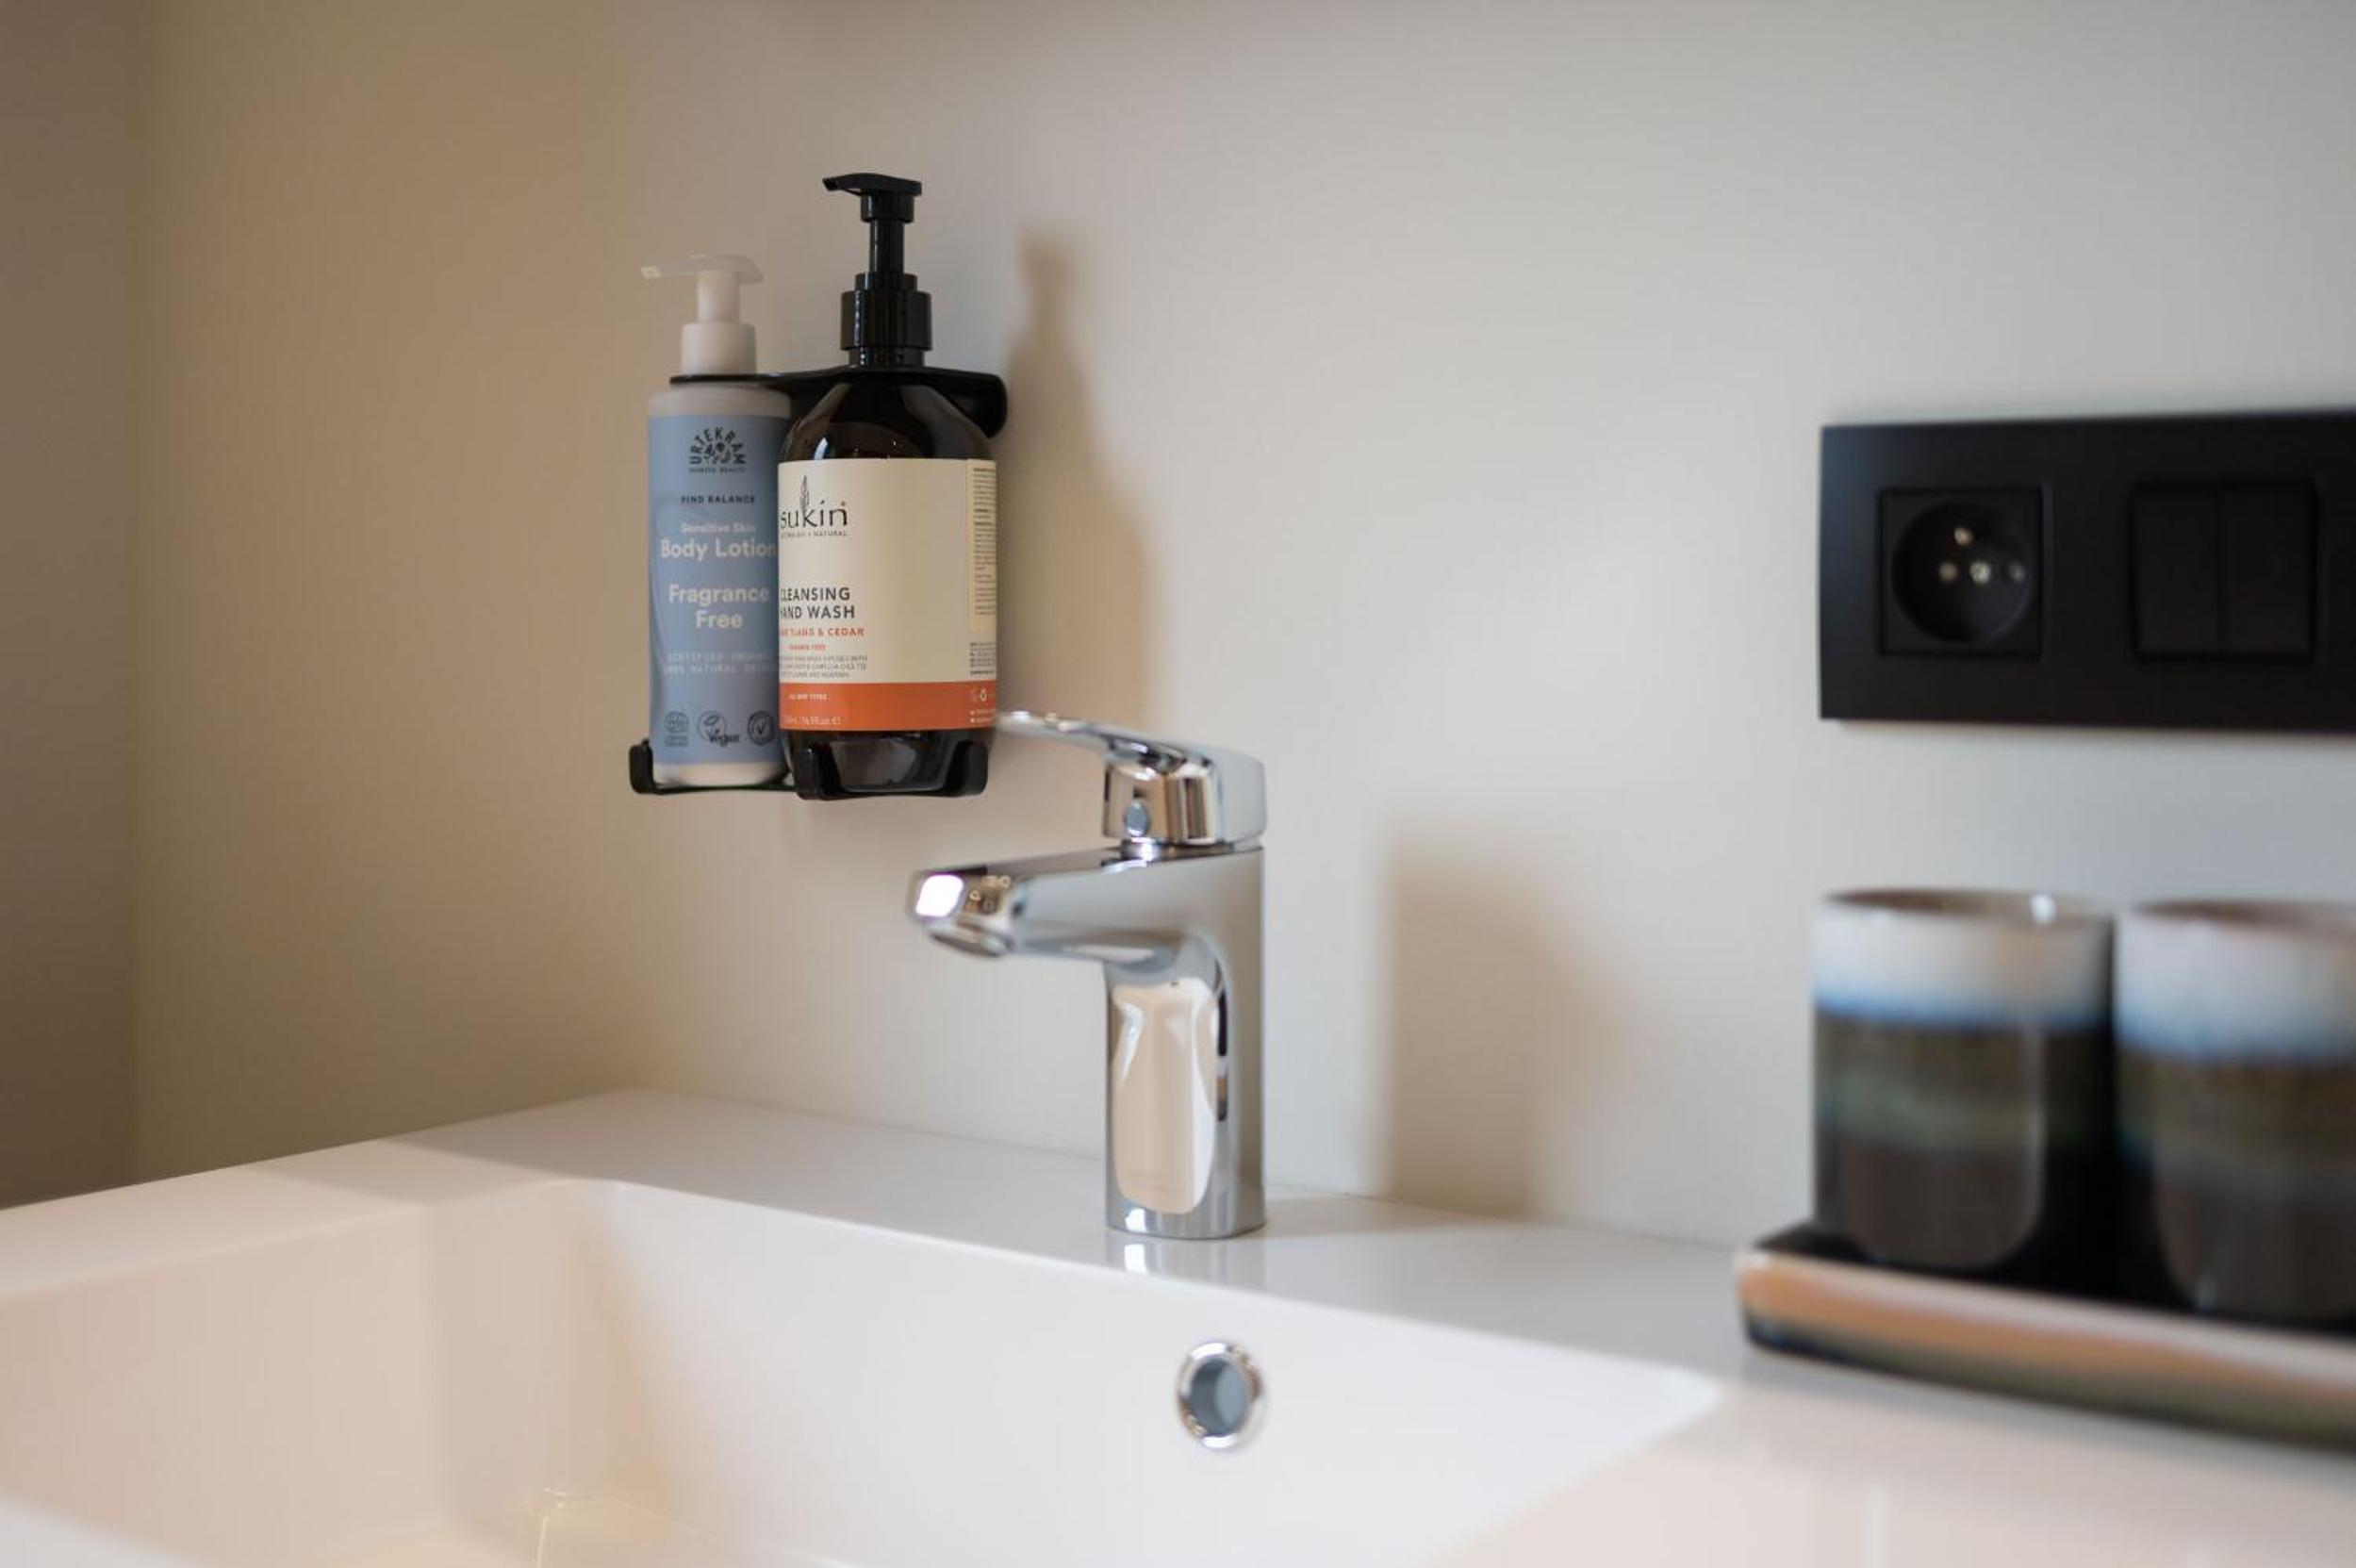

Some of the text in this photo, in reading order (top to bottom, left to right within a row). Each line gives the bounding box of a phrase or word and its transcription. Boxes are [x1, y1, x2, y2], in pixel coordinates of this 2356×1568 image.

[689, 427, 747, 465] URTEKRAM
[681, 495, 755, 503] FIND BALANCE
[781, 491, 848, 529] sukin
[681, 522, 730, 534] Sensitive
[661, 538, 777, 561] Body Lotion
[668, 584, 769, 607] Fragrance
[696, 610, 743, 629] Free
[807, 605, 855, 619] WASH
[827, 628, 865, 636] CEDAR
